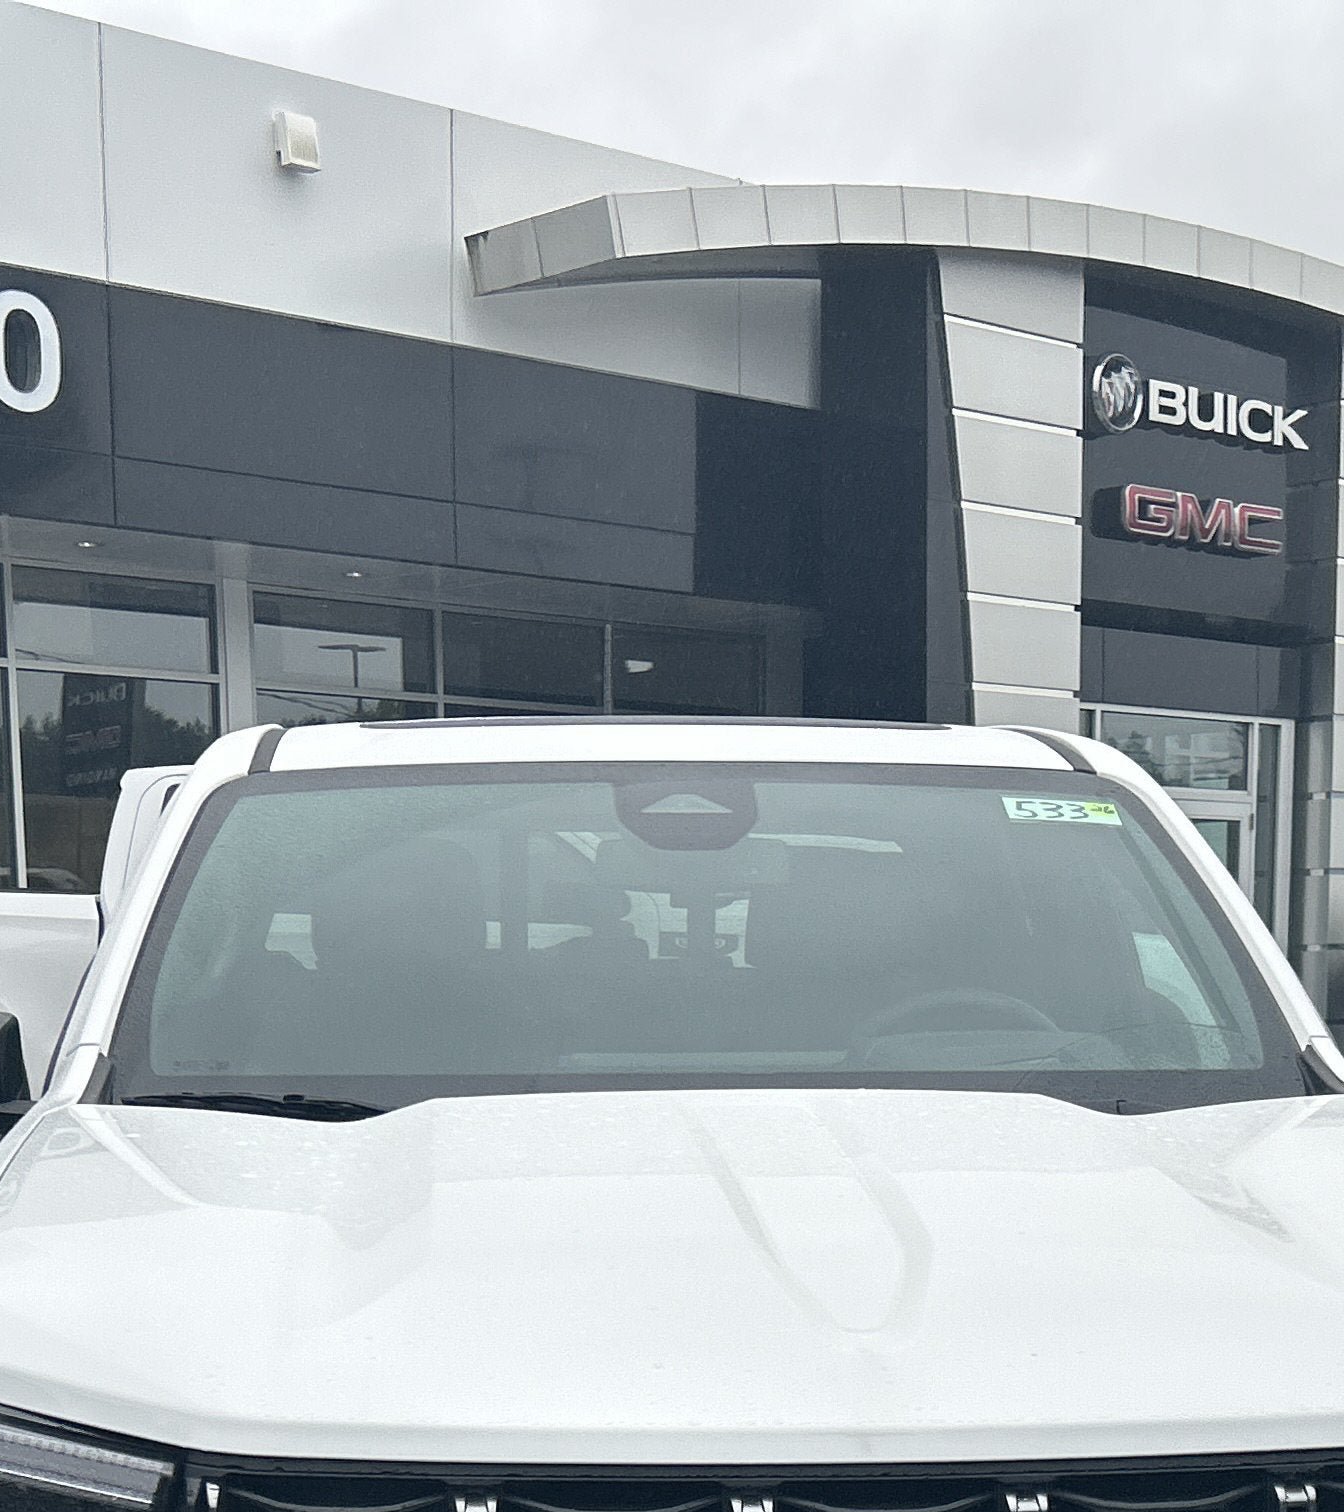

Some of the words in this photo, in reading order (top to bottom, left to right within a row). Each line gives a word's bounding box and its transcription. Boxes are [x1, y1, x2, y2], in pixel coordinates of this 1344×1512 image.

[1147, 377, 1310, 451] BUICK
[1123, 483, 1284, 554] GMC
[1013, 800, 1089, 820] 533
